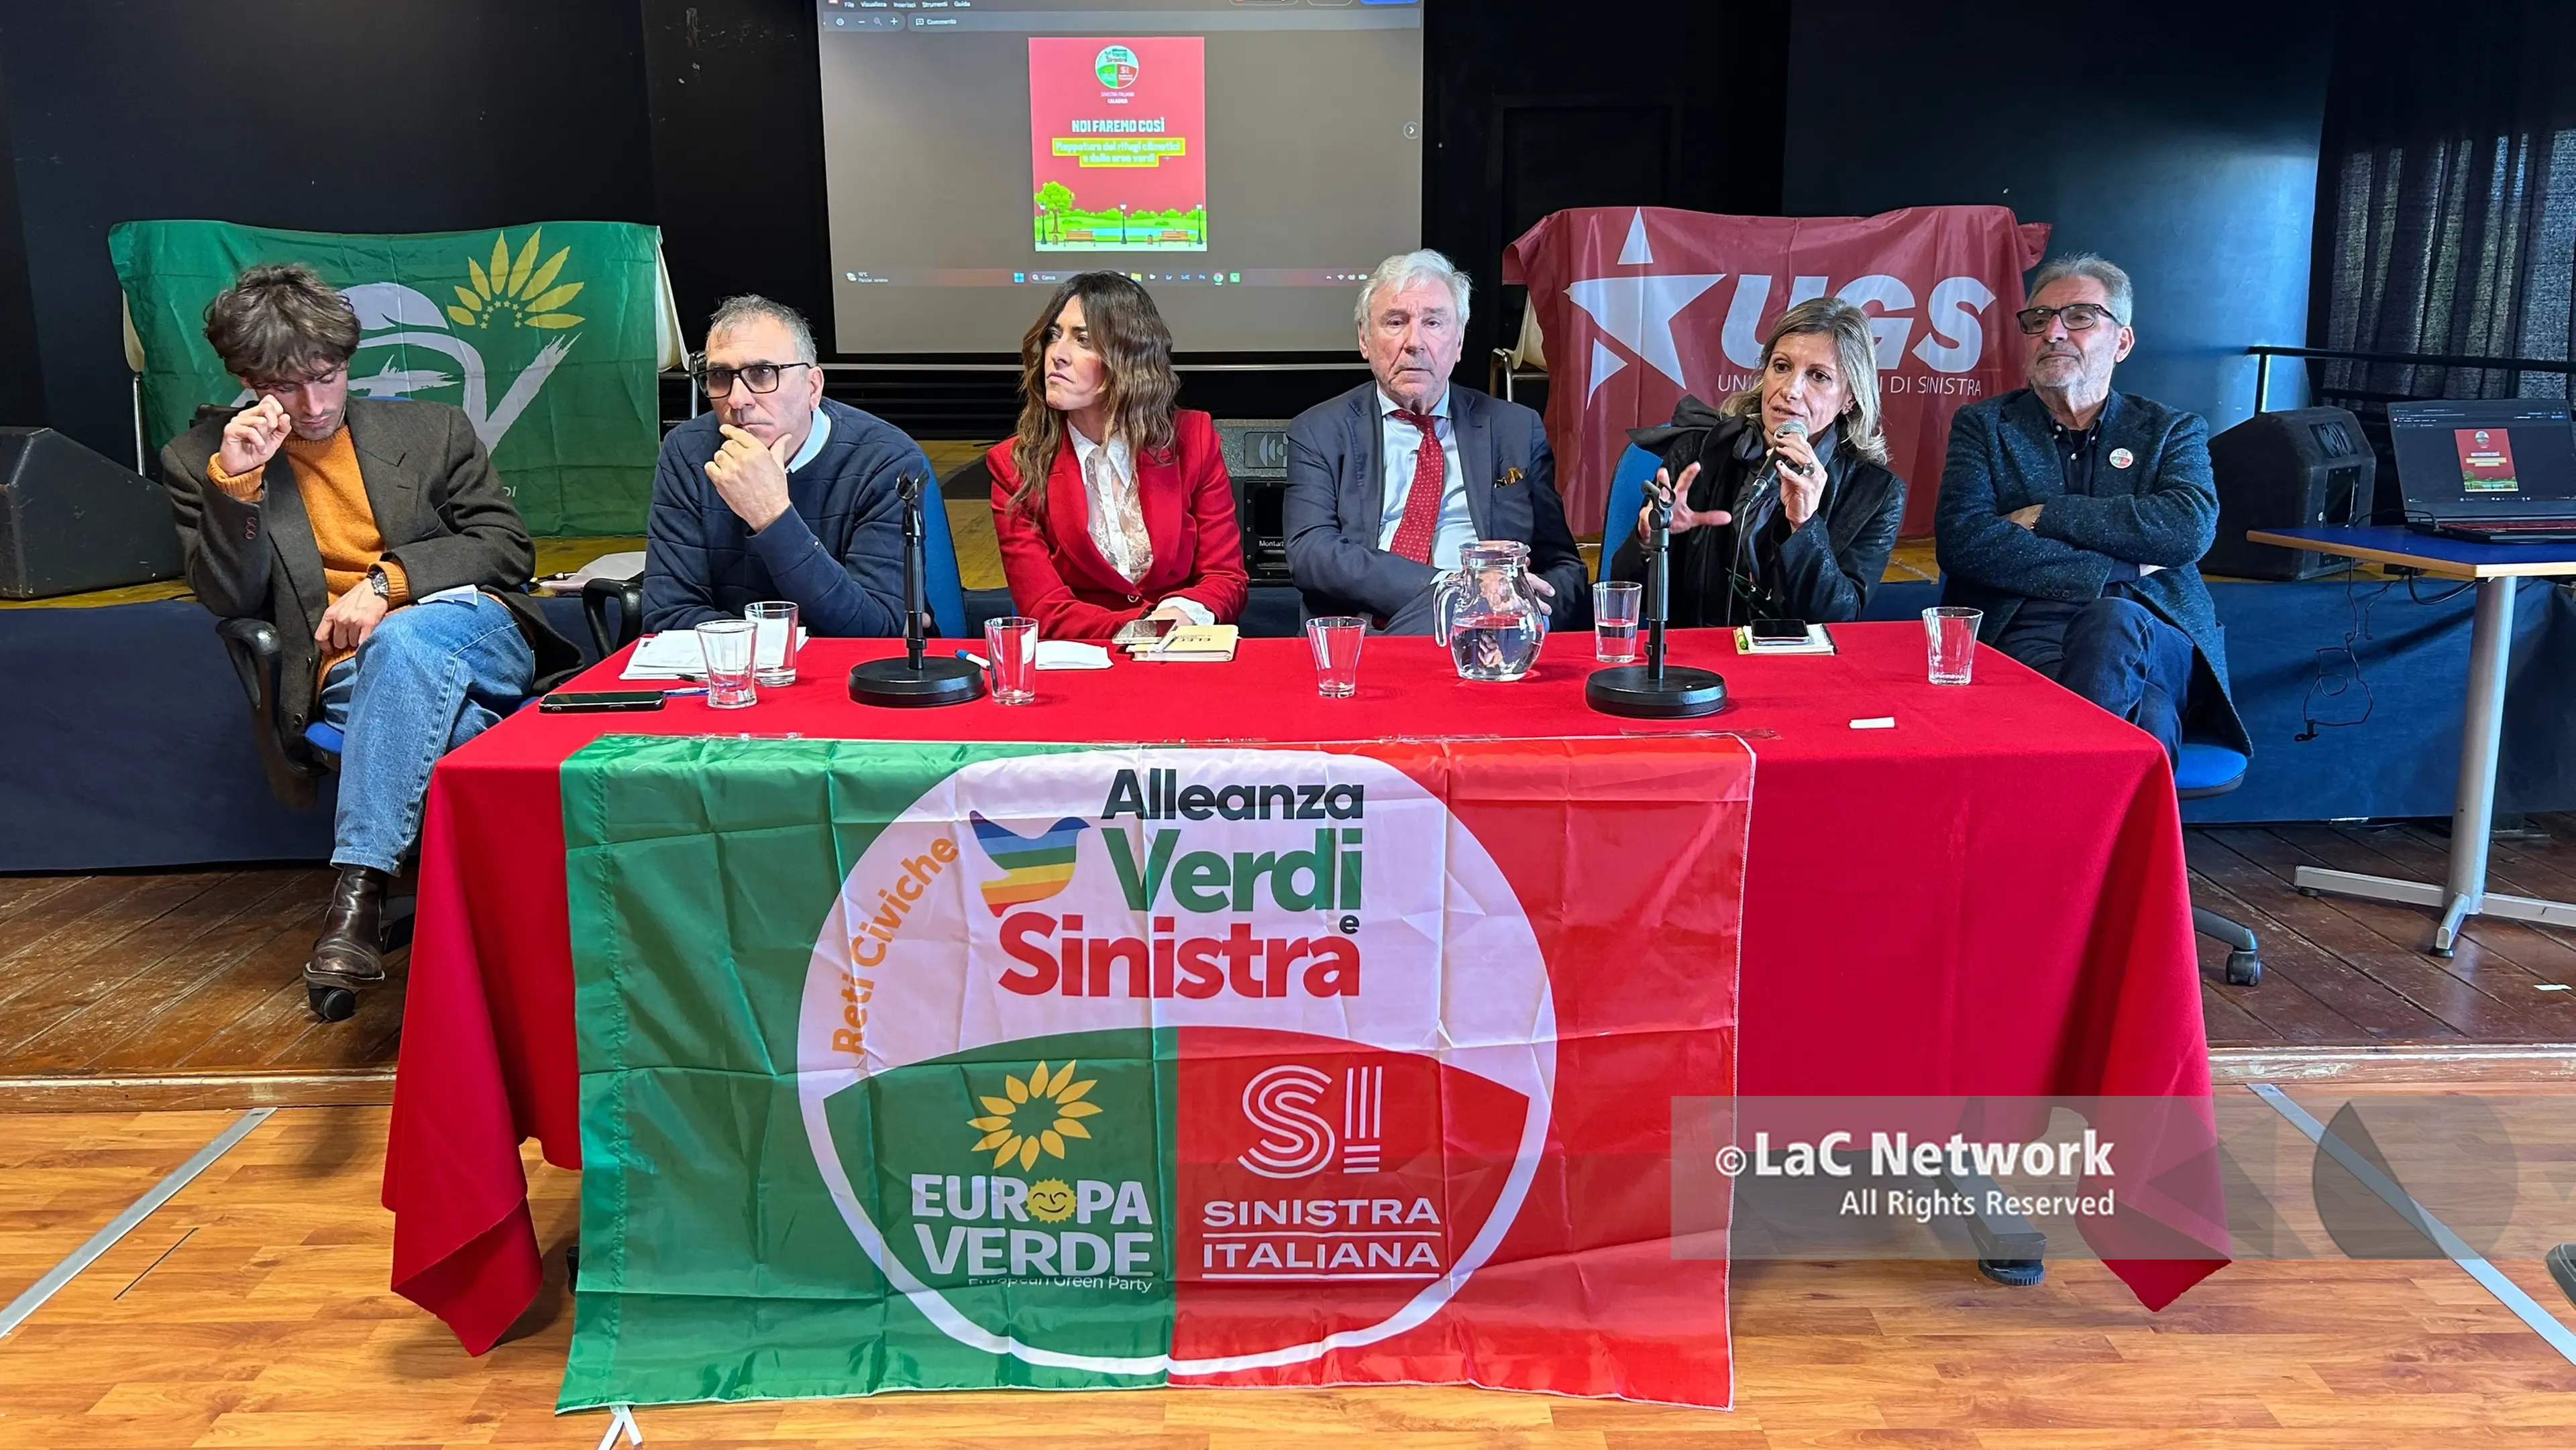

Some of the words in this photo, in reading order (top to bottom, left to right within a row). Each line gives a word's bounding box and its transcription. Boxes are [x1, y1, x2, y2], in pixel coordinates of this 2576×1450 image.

[1071, 119, 1091, 133] NOI
[1093, 119, 1137, 133] FAREMO
[1138, 117, 1165, 133] COSÌ
[1117, 142, 1141, 153] rifugi
[1142, 141, 1181, 151] climatici
[1890, 376, 1911, 394] DI
[1917, 376, 1981, 396] SINISTRA
[1101, 768, 1364, 821] Alleanza
[1101, 828, 1362, 913] Verdi
[851, 838, 959, 967] Civiche
[1339, 914, 1360, 934] e
[998, 911, 1360, 999] Sinistra
[832, 973, 875, 1055] Reti
[1202, 1197, 1441, 1227] SINISTRA
[913, 1223, 1154, 1276] VERDE
[1203, 1242, 1440, 1270] ITALIANA
[1108, 1276, 1152, 1294] Party
